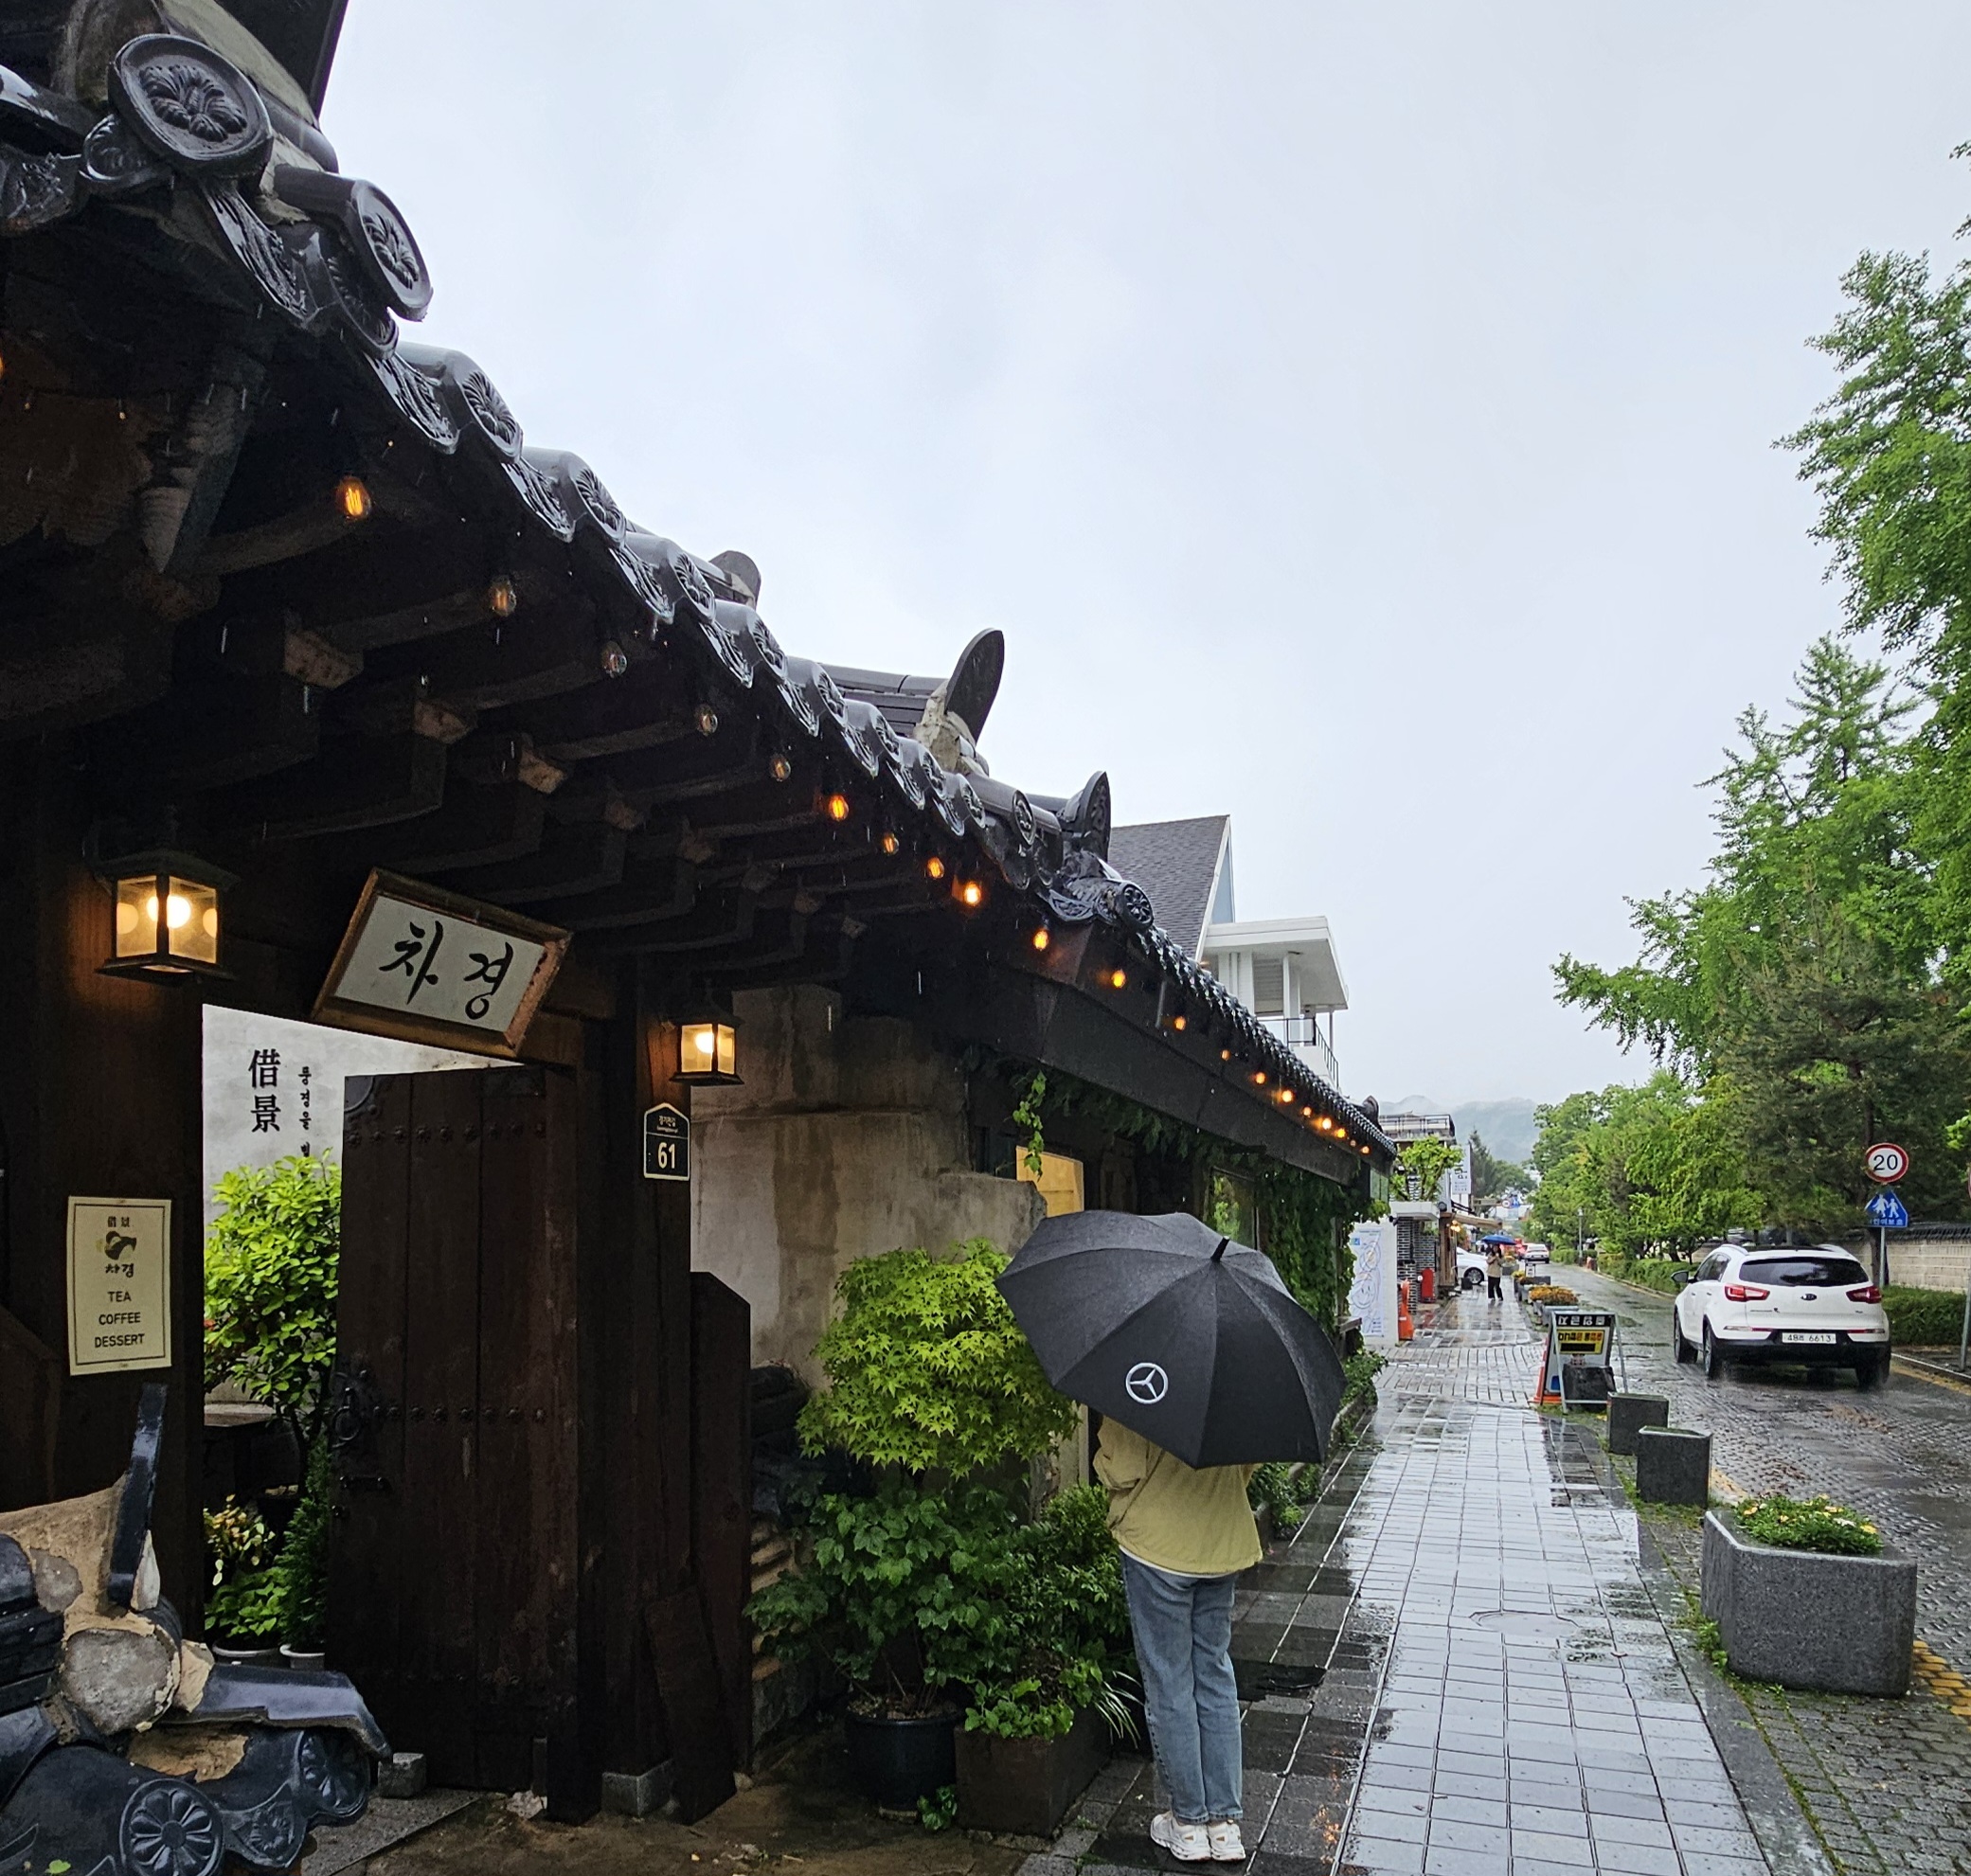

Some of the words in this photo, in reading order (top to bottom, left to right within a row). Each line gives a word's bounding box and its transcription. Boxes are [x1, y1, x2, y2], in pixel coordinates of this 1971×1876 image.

[378, 920, 513, 1021] 차경
[248, 1048, 282, 1133] 借景
[657, 1141, 675, 1170] 61
[1872, 1153, 1898, 1171] 20
[104, 1261, 135, 1278] 차경
[107, 1291, 132, 1303] TEA
[99, 1311, 141, 1326] COFFEE
[94, 1332, 145, 1349] DESSERT
